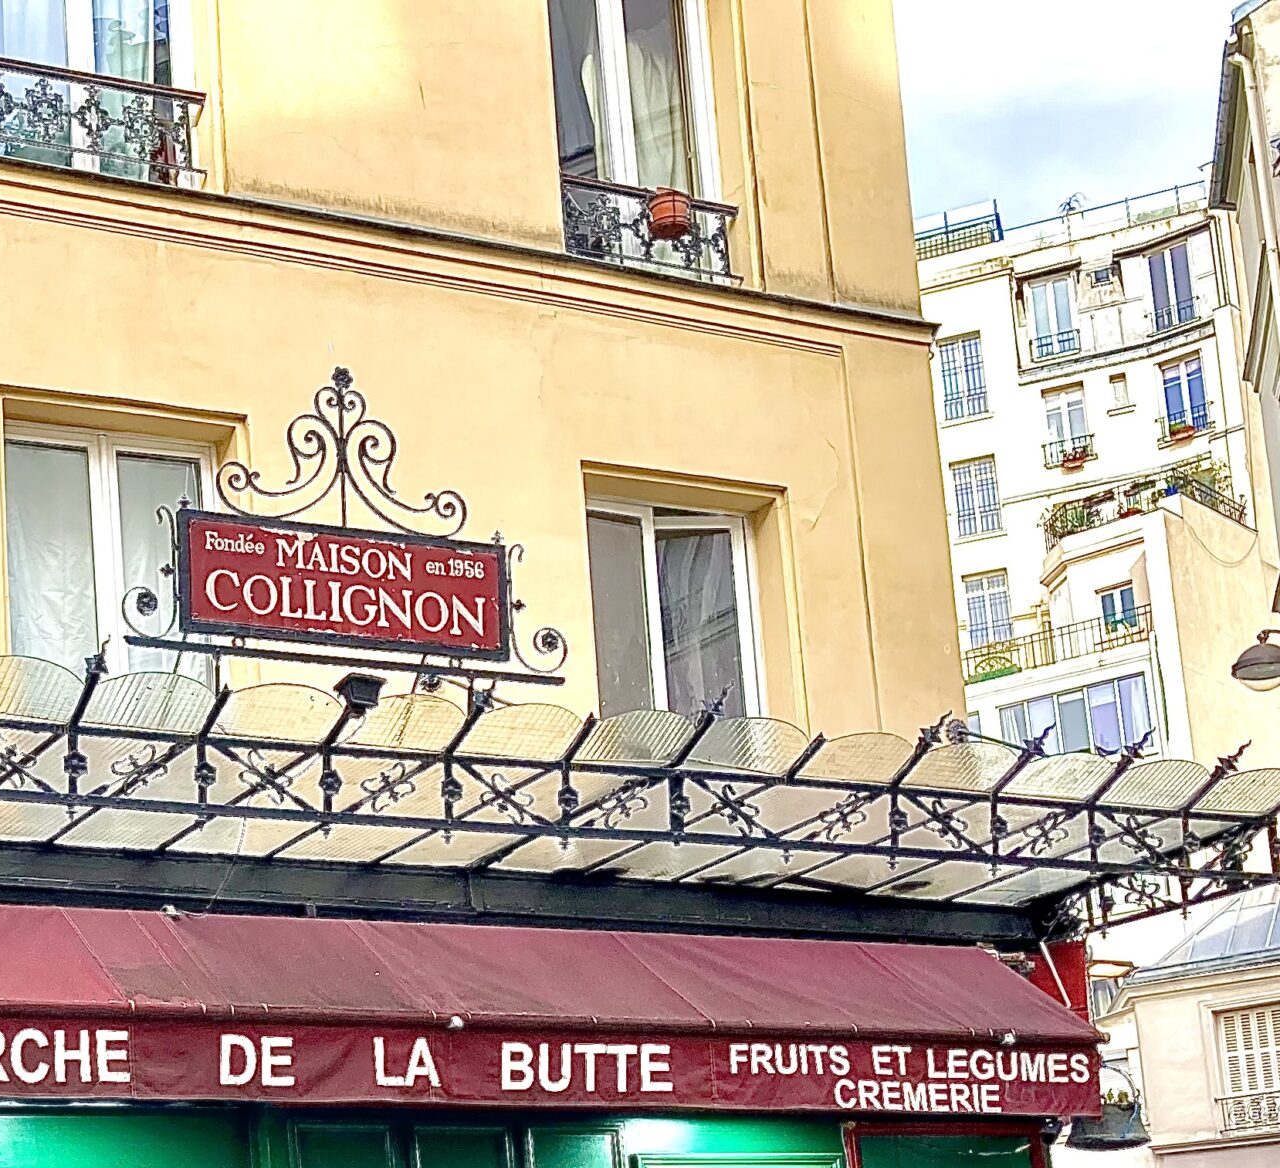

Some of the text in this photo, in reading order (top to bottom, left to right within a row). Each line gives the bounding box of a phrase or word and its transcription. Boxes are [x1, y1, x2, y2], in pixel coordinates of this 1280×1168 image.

[205, 530, 485, 582] Fondée MAISON en 1956
[205, 569, 487, 636] COLLIGNON
[219, 1033, 295, 1088] DE
[373, 1036, 442, 1088] LA
[501, 1042, 674, 1093] BUTTE
[728, 1042, 1091, 1084] FRUITS ET LEGUMES
[834, 1078, 1003, 1114] CREMERIE
